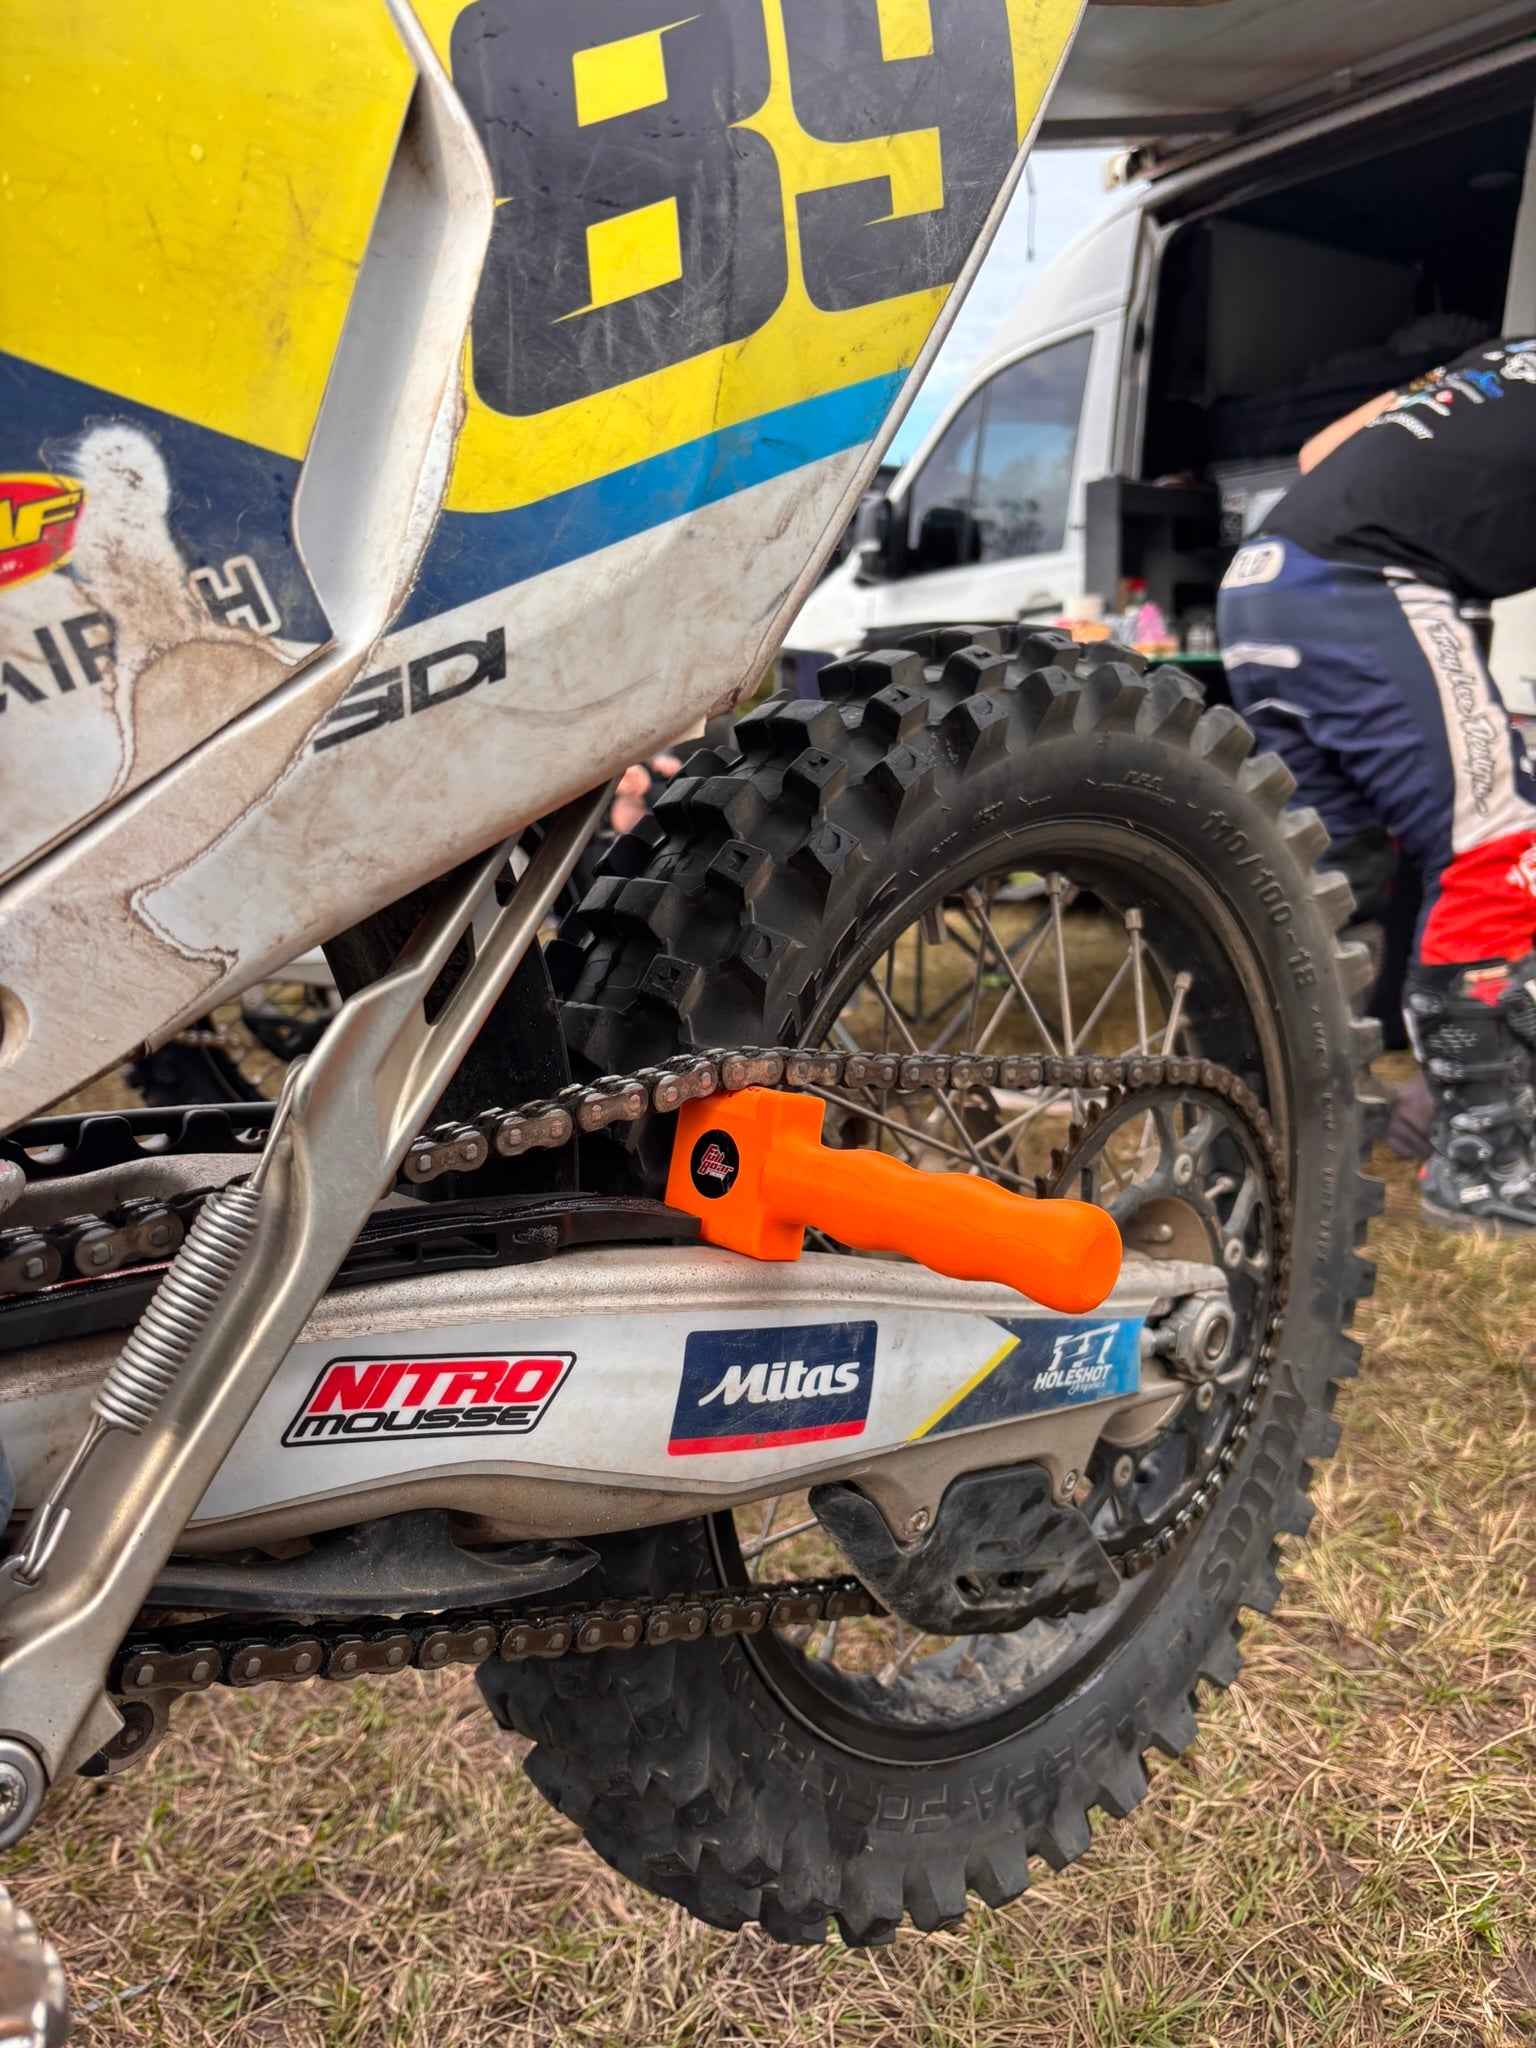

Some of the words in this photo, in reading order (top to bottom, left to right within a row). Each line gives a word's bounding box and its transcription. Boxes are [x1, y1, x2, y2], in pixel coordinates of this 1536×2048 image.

[449, 0, 1019, 418] 89
[308, 1359, 565, 1413] NITRO
[698, 1360, 861, 1407] Mitas
[1033, 1364, 1113, 1392] HOLESHOT
